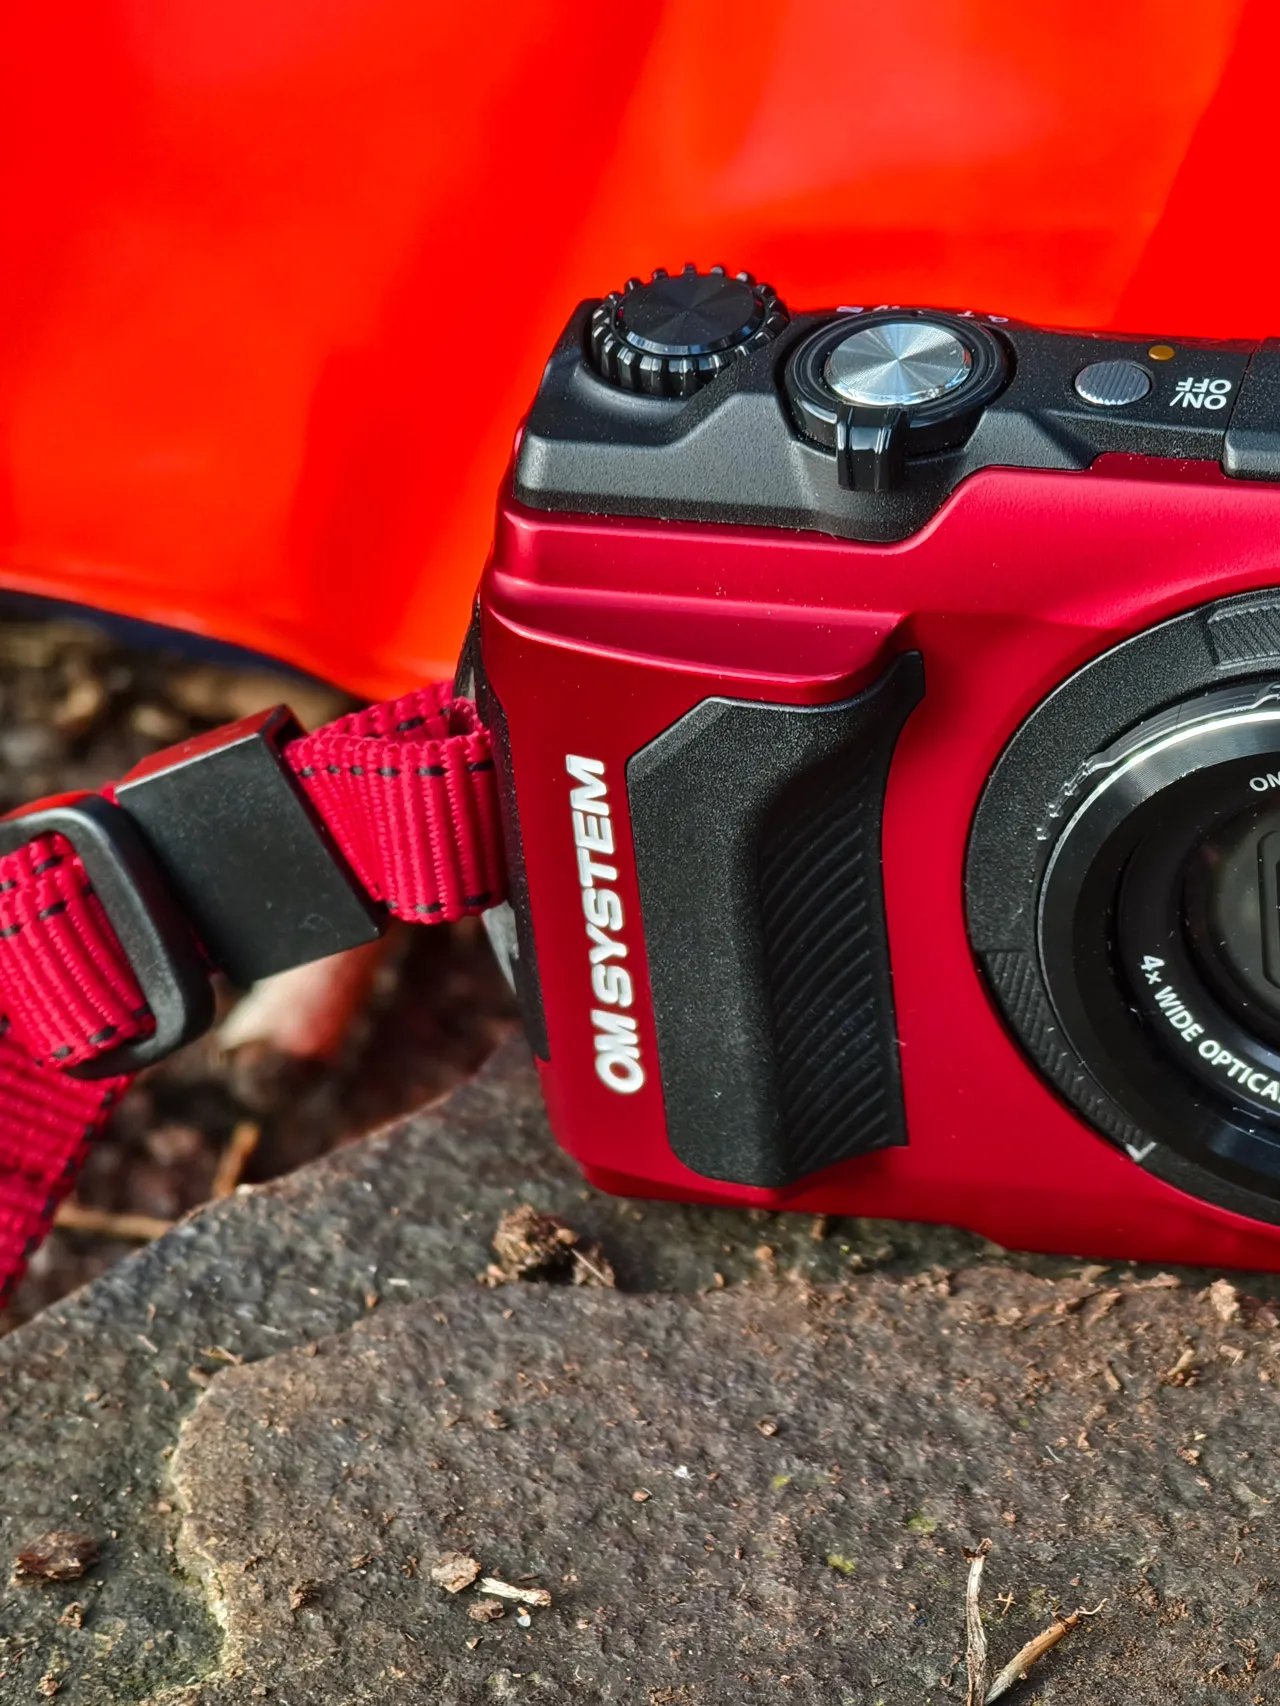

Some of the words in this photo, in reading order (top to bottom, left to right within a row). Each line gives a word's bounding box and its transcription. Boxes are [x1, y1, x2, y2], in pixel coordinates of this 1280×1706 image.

[1169, 392, 1228, 411] ON/
[1175, 377, 1232, 394] OFF
[565, 753, 633, 1008] SYSTEM
[1140, 955, 1165, 985] 4x
[1154, 985, 1205, 1042] WIDE
[590, 1008, 645, 1095] OM
